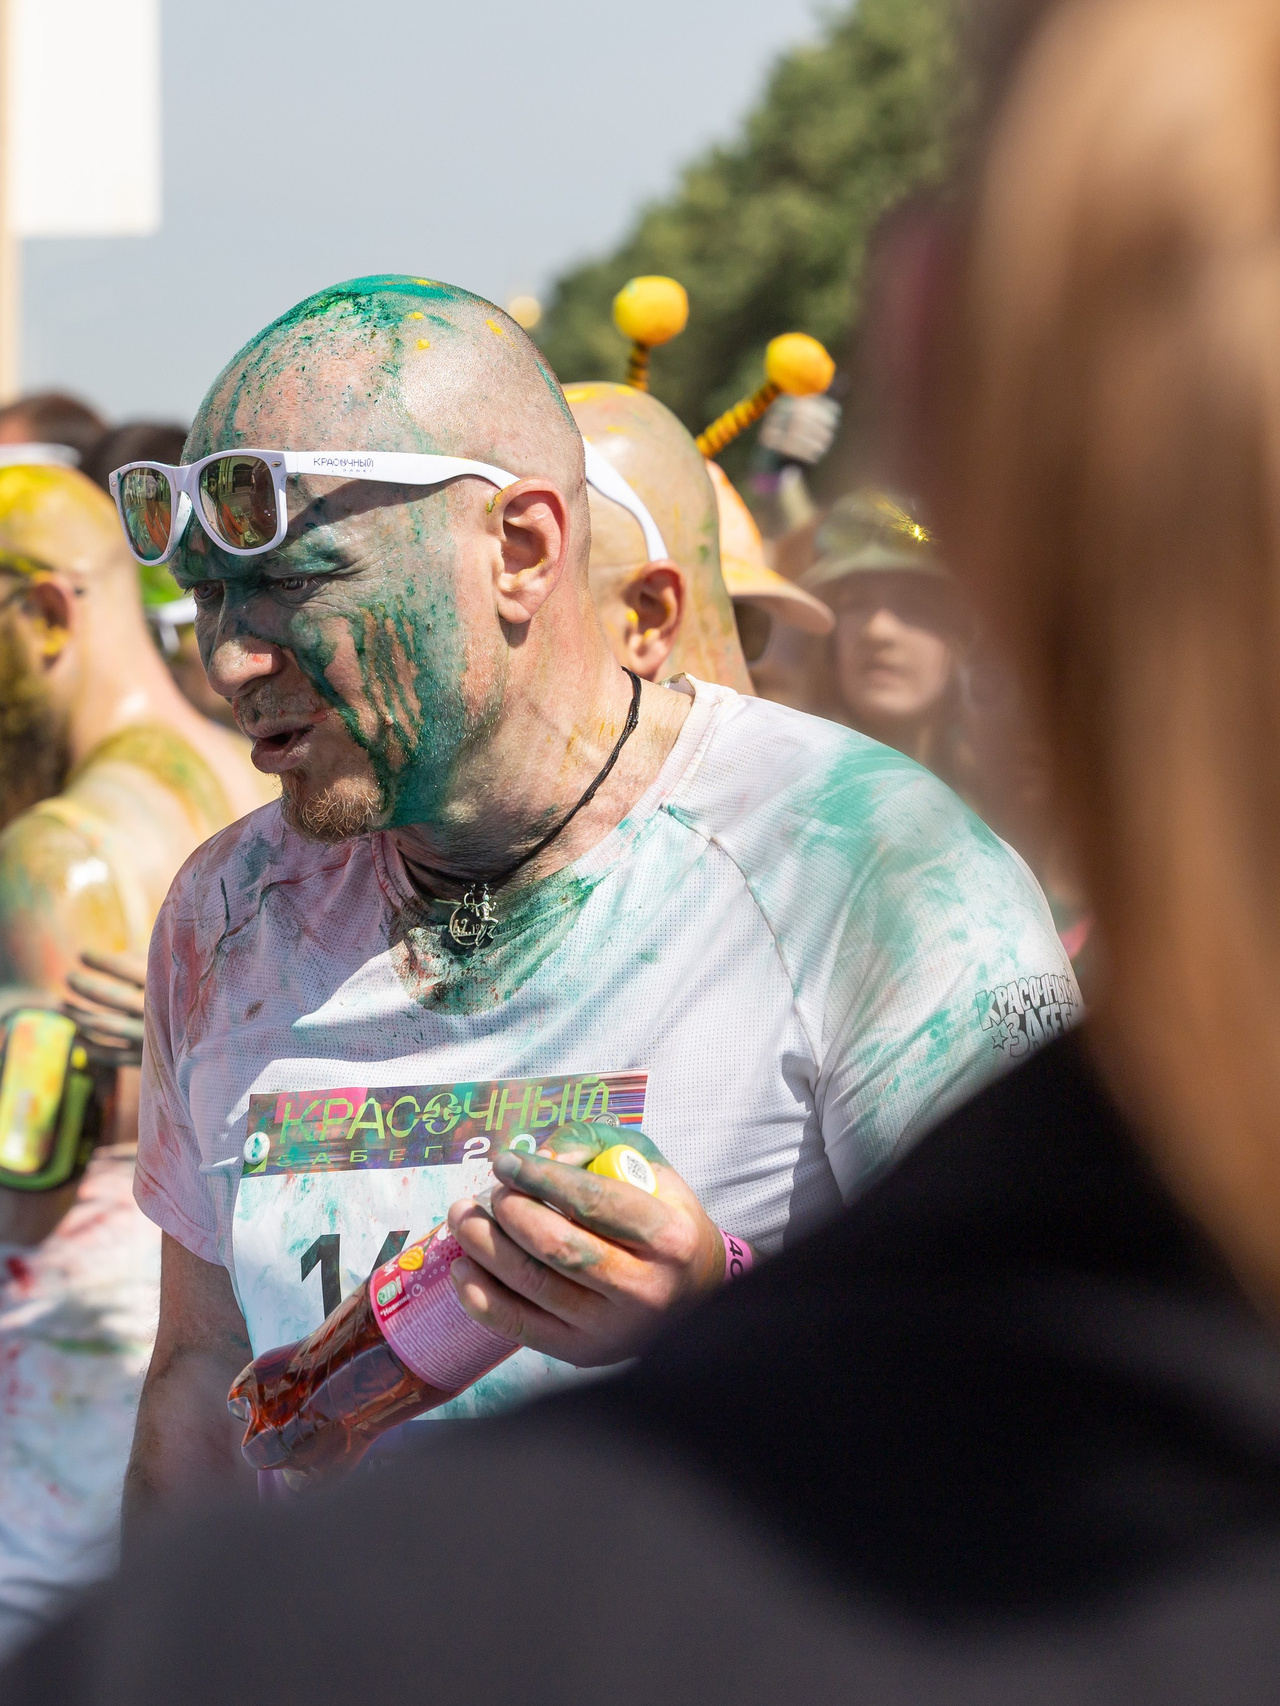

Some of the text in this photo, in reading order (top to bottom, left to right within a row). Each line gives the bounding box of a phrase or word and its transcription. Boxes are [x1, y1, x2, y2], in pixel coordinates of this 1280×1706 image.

[313, 458, 374, 467] КРАСОЧНЫЙ
[279, 1076, 610, 1144] КРАСОЧНЫЙ
[276, 1145, 442, 1167] ЗАБЕГ
